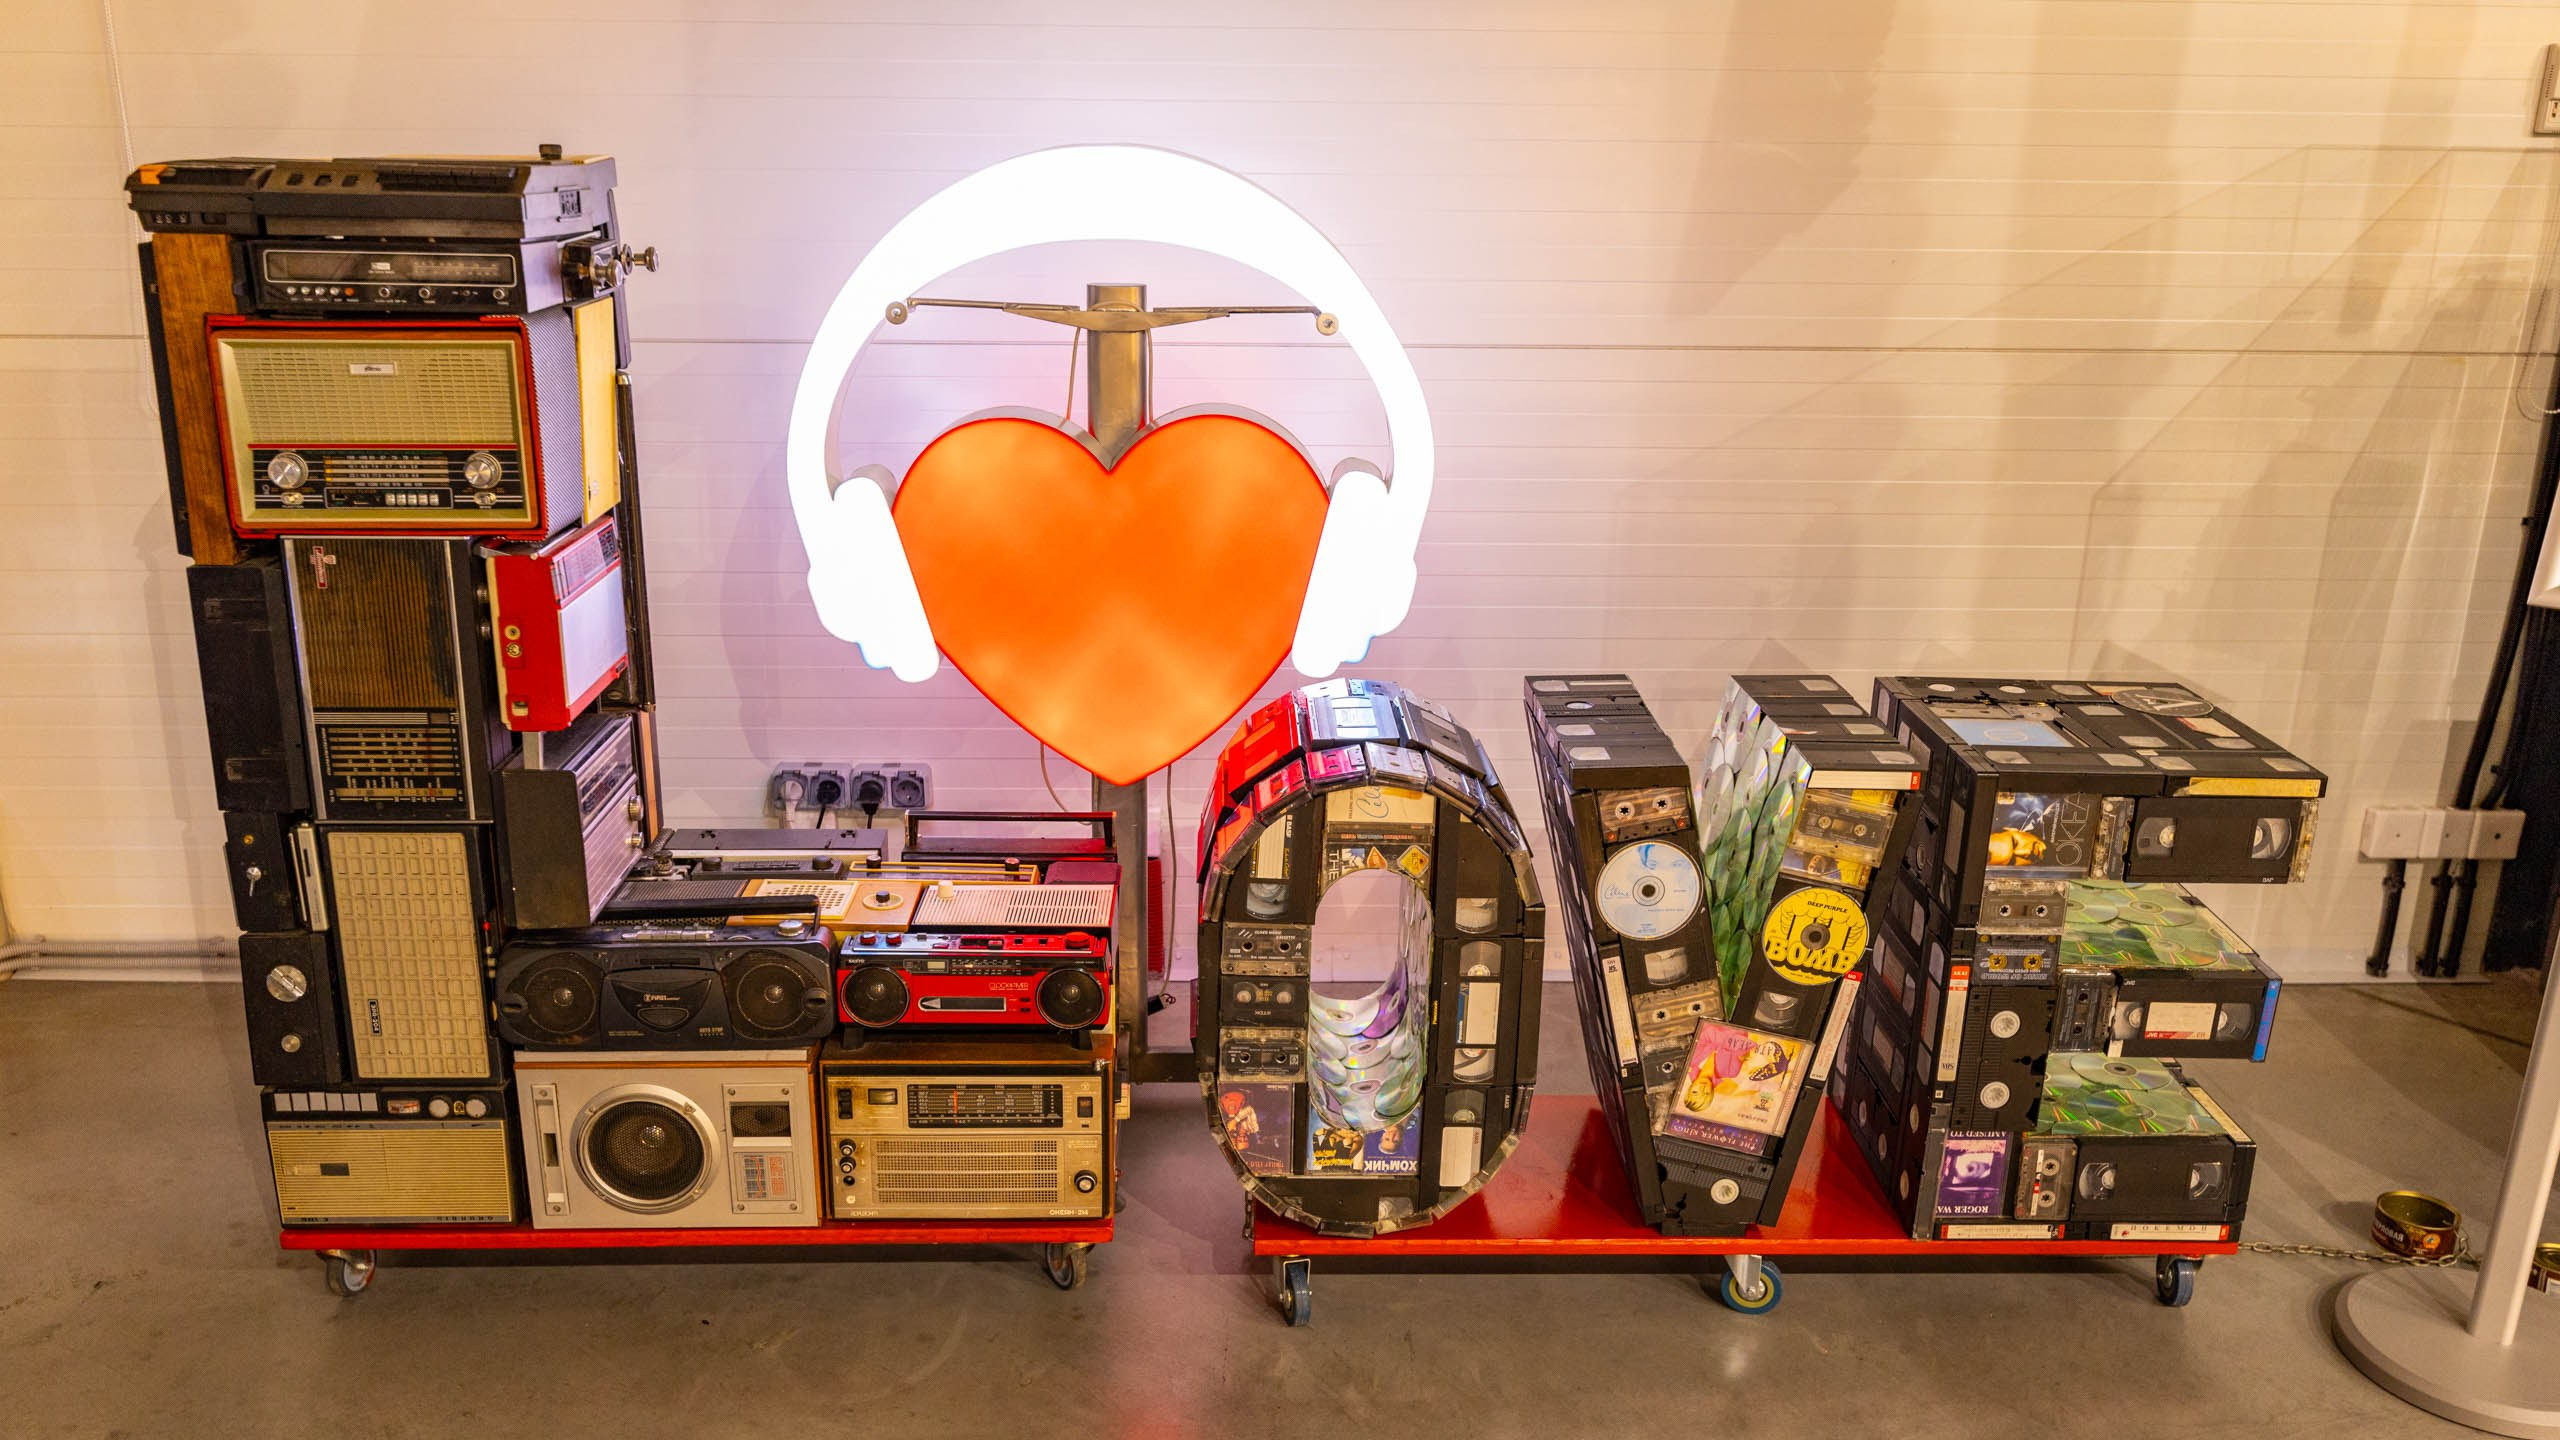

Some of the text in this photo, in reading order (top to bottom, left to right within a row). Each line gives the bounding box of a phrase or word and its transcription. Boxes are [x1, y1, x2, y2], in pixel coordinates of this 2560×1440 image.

[1328, 849, 1340, 881] THE
[1807, 900, 1849, 914] DEEP PURPLE
[1766, 937, 1857, 974] BOMB
[1673, 1124, 1757, 1151] THE FLOWER KINGS
[1364, 1160, 1417, 1172] ХОМЧИК
[1954, 1205, 1989, 1214] ROGER
